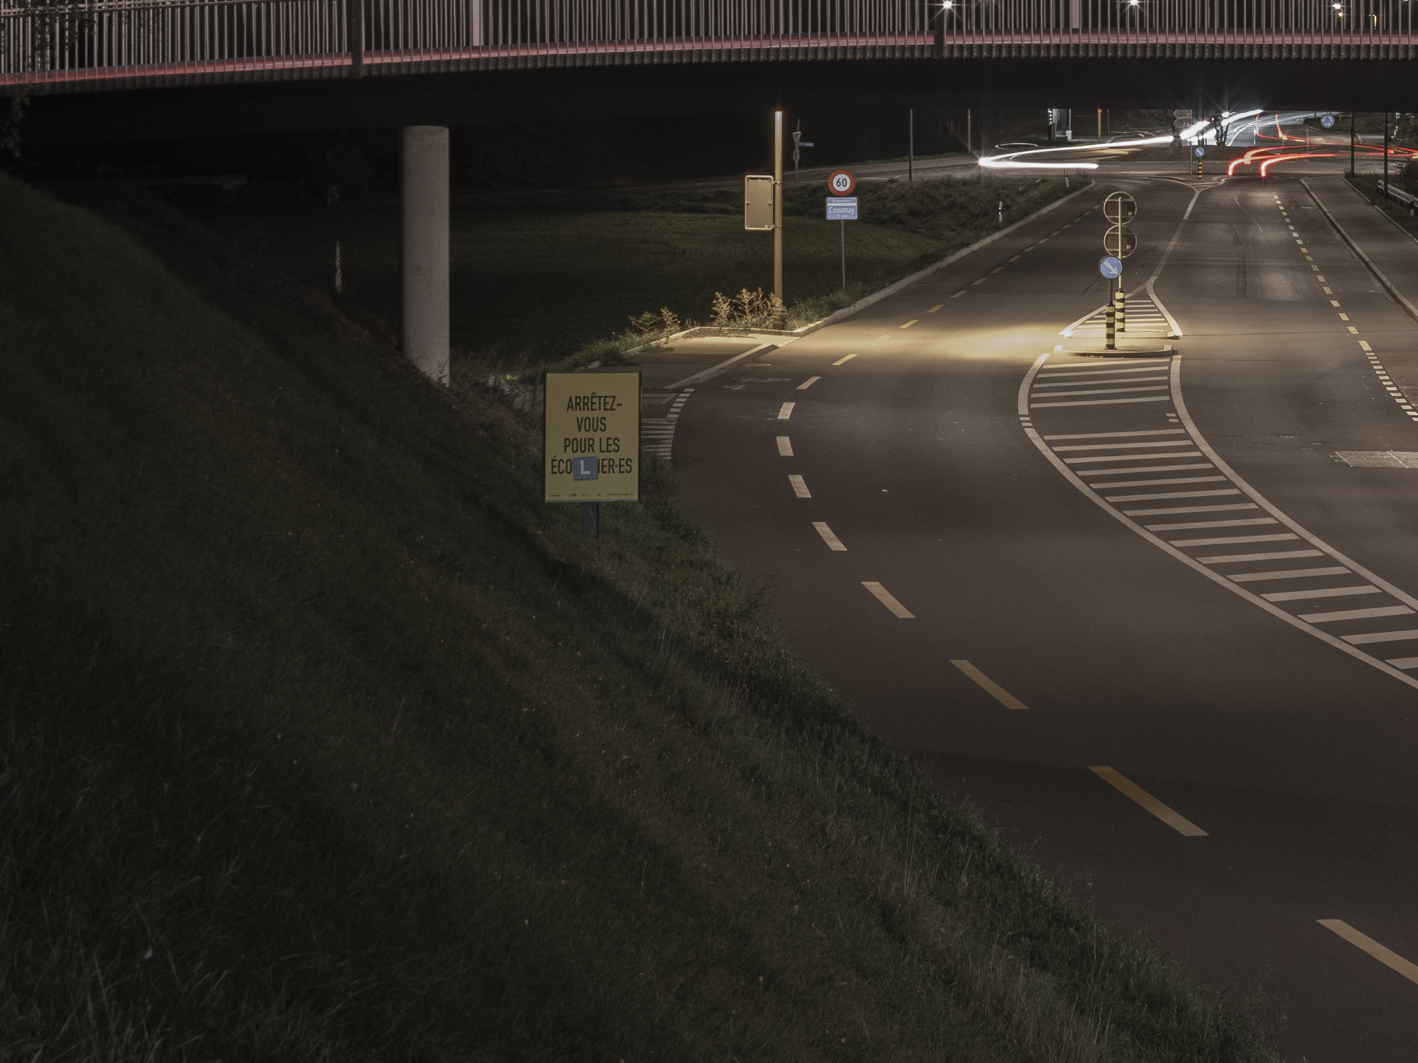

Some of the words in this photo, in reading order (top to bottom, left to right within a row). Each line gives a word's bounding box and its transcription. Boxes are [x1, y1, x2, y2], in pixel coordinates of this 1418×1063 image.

[836, 178, 848, 187] 60
[828, 206, 855, 215] Cossonay
[566, 392, 623, 412] ARRÊTEZ-
[576, 416, 607, 432] VOUS
[564, 437, 595, 453] POUR
[599, 437, 620, 453] LES
